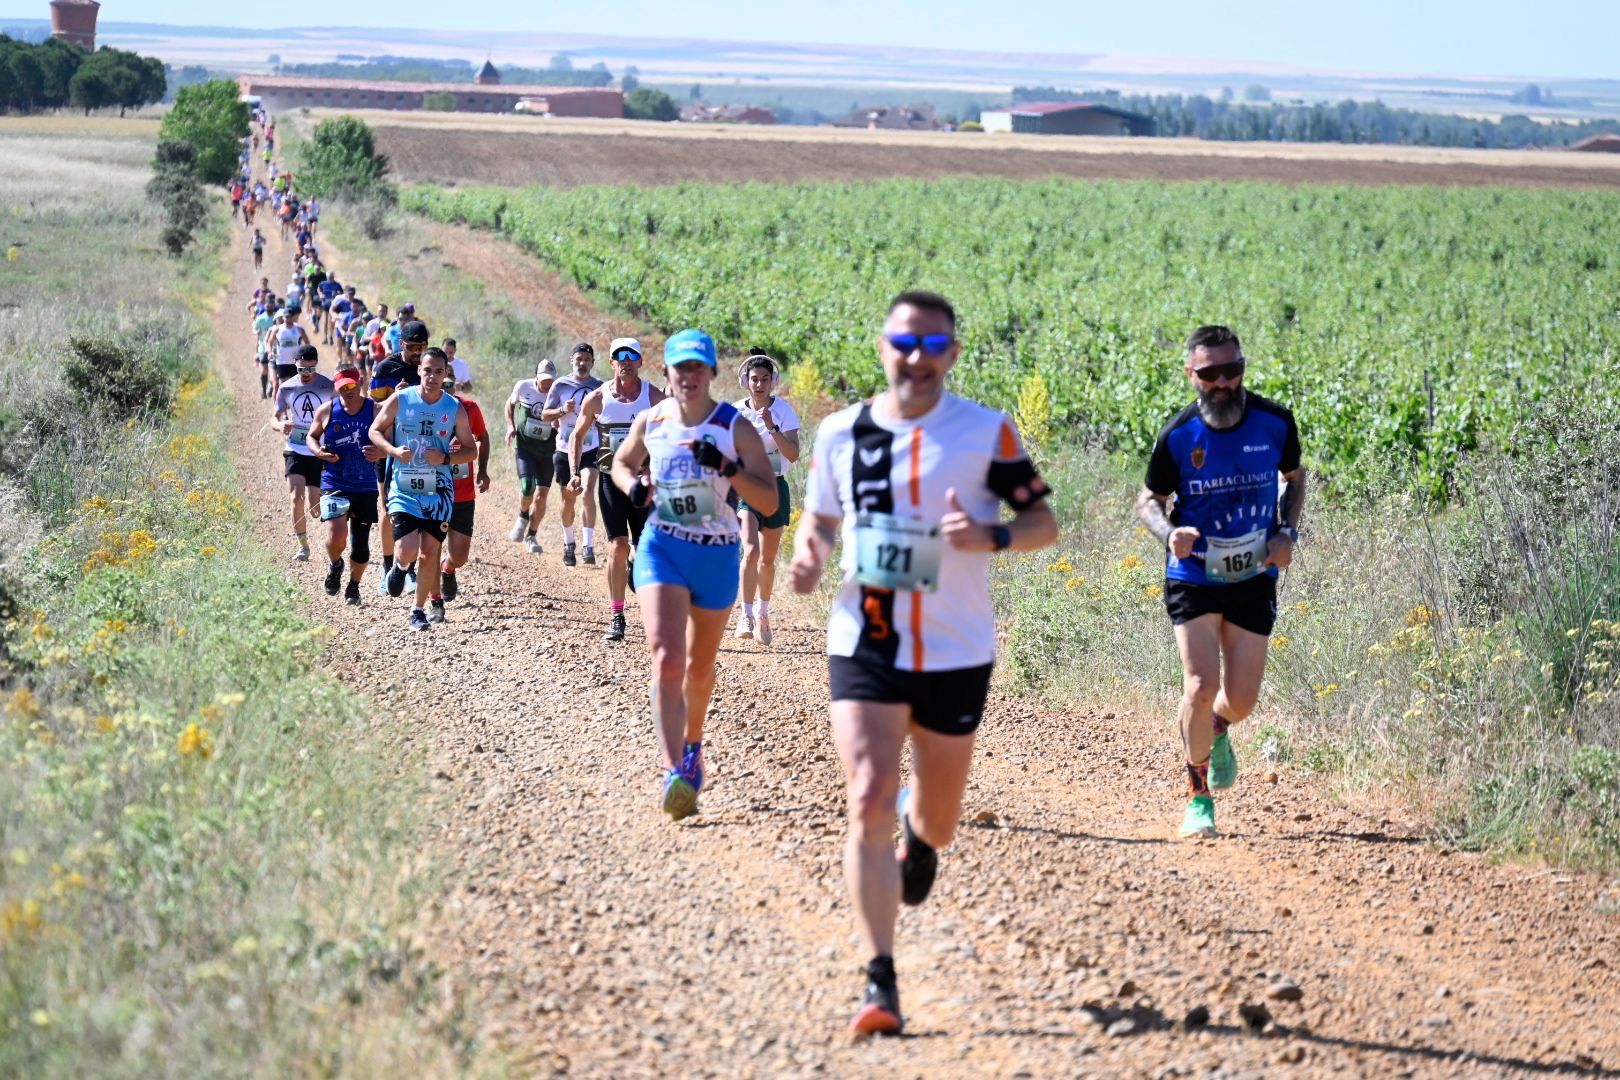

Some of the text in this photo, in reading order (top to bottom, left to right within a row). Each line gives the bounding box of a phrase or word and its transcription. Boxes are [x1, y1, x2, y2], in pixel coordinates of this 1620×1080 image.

[410, 478, 425, 490] 59
[327, 502, 337, 513] 19
[876, 543, 913, 574] 121
[1222, 551, 1254, 573] 162
